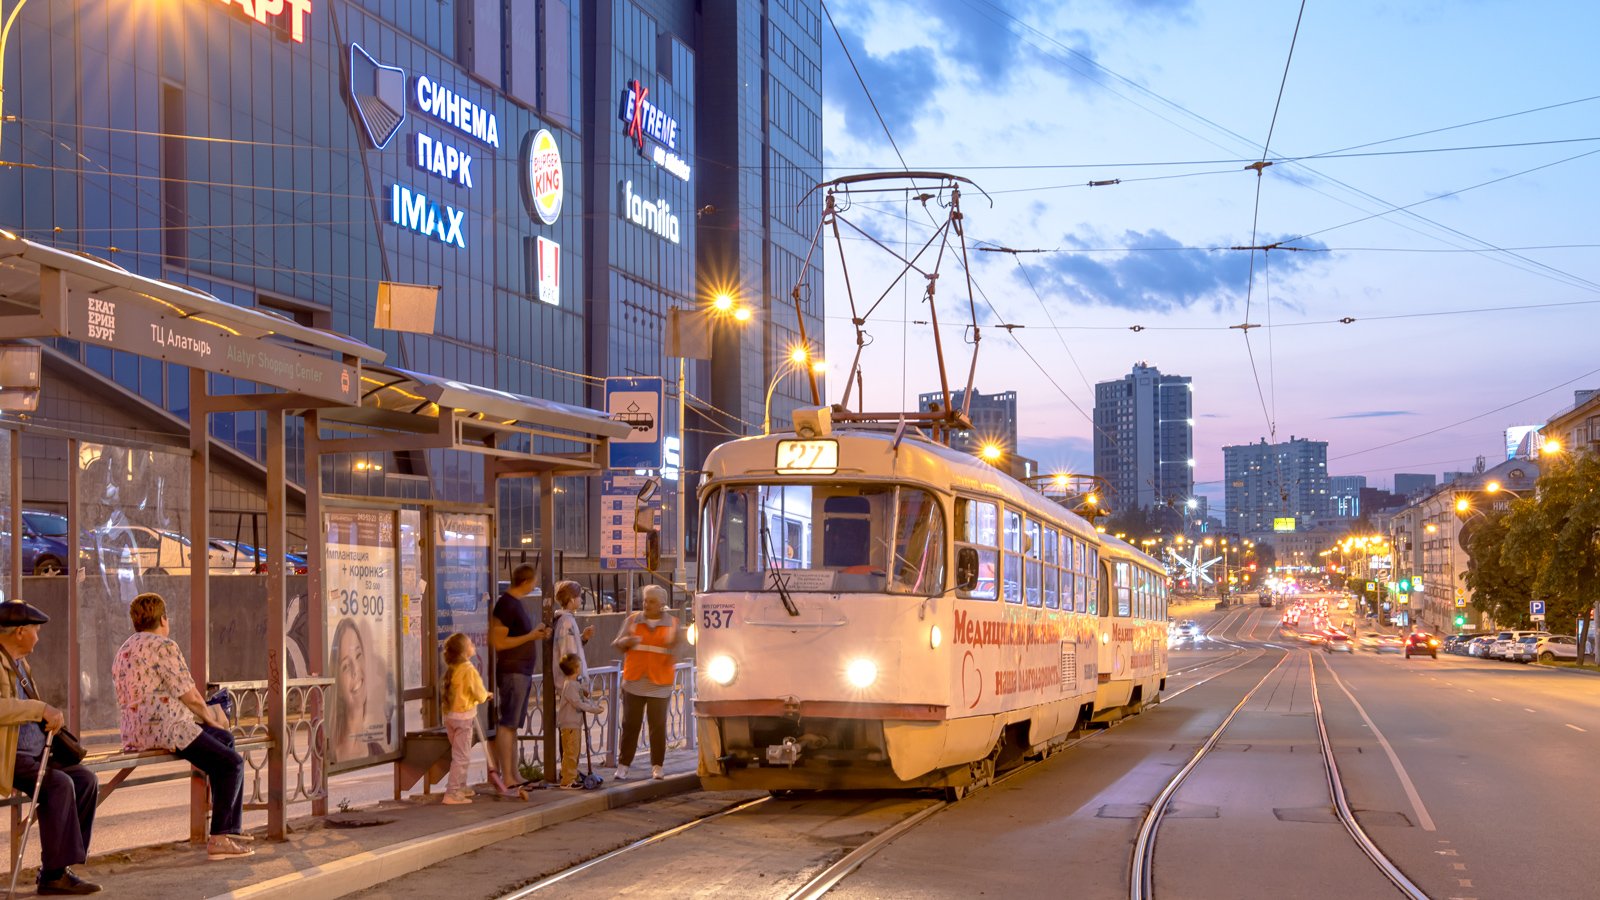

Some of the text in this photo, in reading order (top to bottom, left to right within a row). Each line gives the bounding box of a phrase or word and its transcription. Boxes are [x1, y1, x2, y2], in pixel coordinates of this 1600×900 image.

[216, 0, 312, 44] РТ
[417, 75, 499, 148] СИНЕМА
[625, 80, 677, 149] EXTREME
[417, 132, 473, 188] ПАРК
[534, 153, 559, 175] BURGER
[535, 168, 560, 198] KING
[392, 183, 466, 249] IMAX
[626, 180, 680, 244] familia
[87, 297, 116, 316] ЕКАТ
[87, 311, 116, 329] ЕРИН
[87, 324, 116, 342] БУРГ
[150, 323, 212, 358] ТЦ Алатырь
[227, 344, 324, 383] Alatyr Shopping Center
[786, 443, 824, 471] 27
[349, 564, 384, 580] коронка
[340, 589, 384, 616] 36 900
[703, 609, 734, 629] 537
